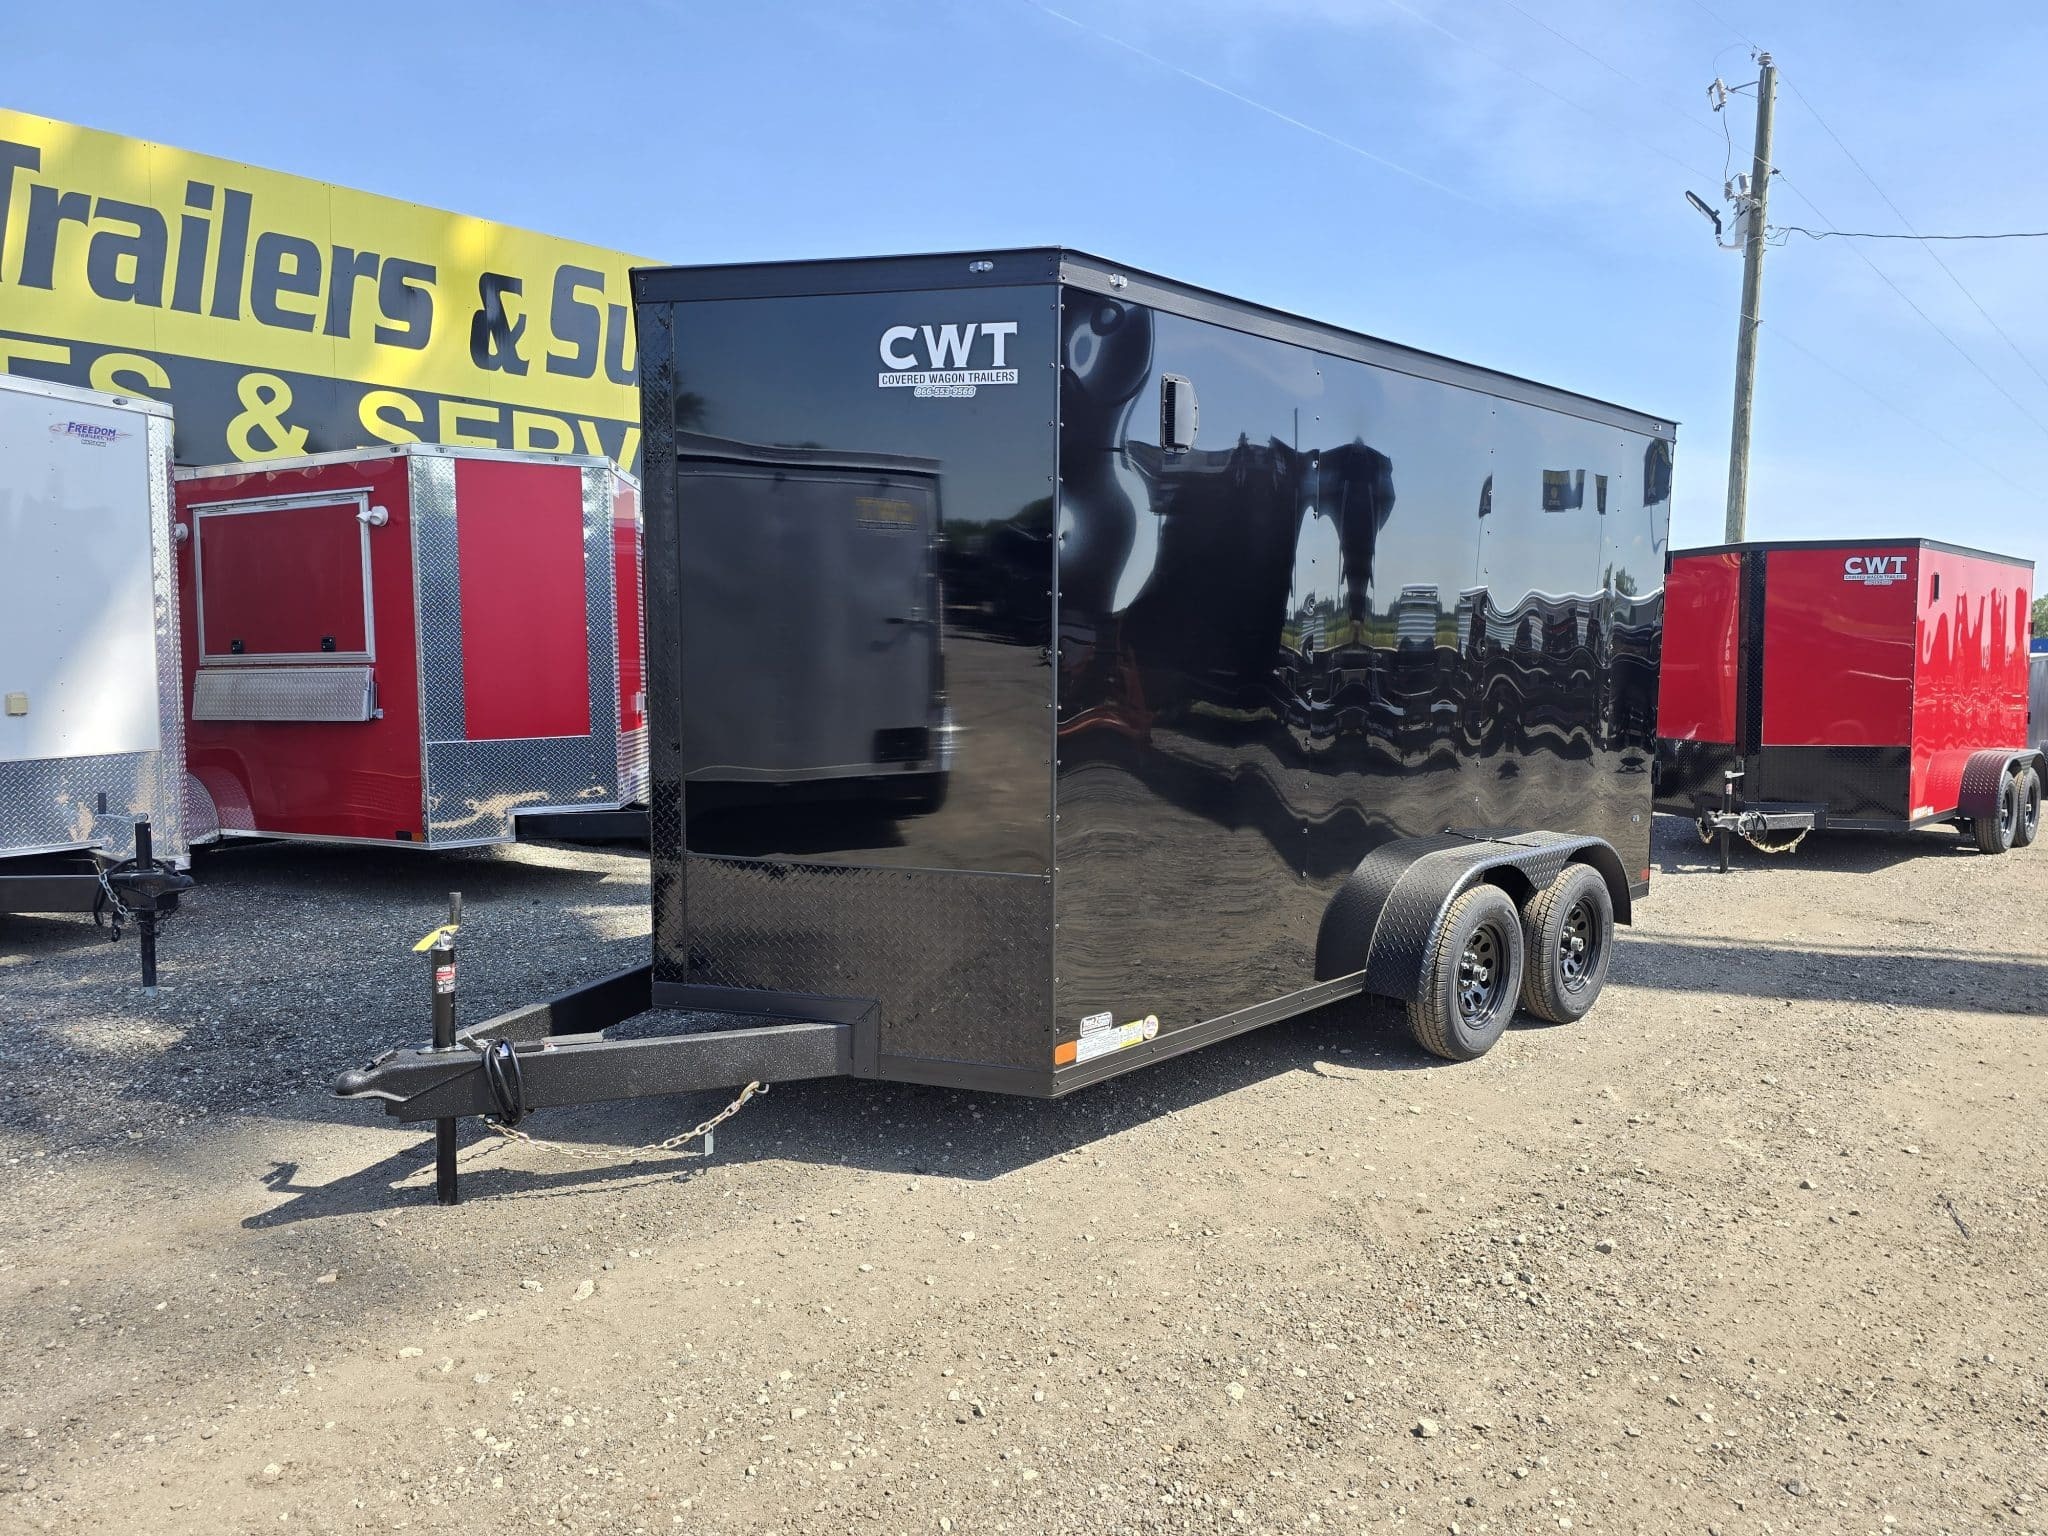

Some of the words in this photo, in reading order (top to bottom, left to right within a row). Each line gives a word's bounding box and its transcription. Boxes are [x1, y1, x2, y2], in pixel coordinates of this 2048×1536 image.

[470, 272, 530, 377] &
[880, 322, 1018, 370] CWT
[882, 373, 926, 385] COVERED
[928, 372, 965, 384] WAGON
[969, 371, 1015, 383] TRAILERS
[68, 422, 116, 437] FREEDOM
[226, 372, 310, 463] &
[1844, 557, 1907, 573] CWT
